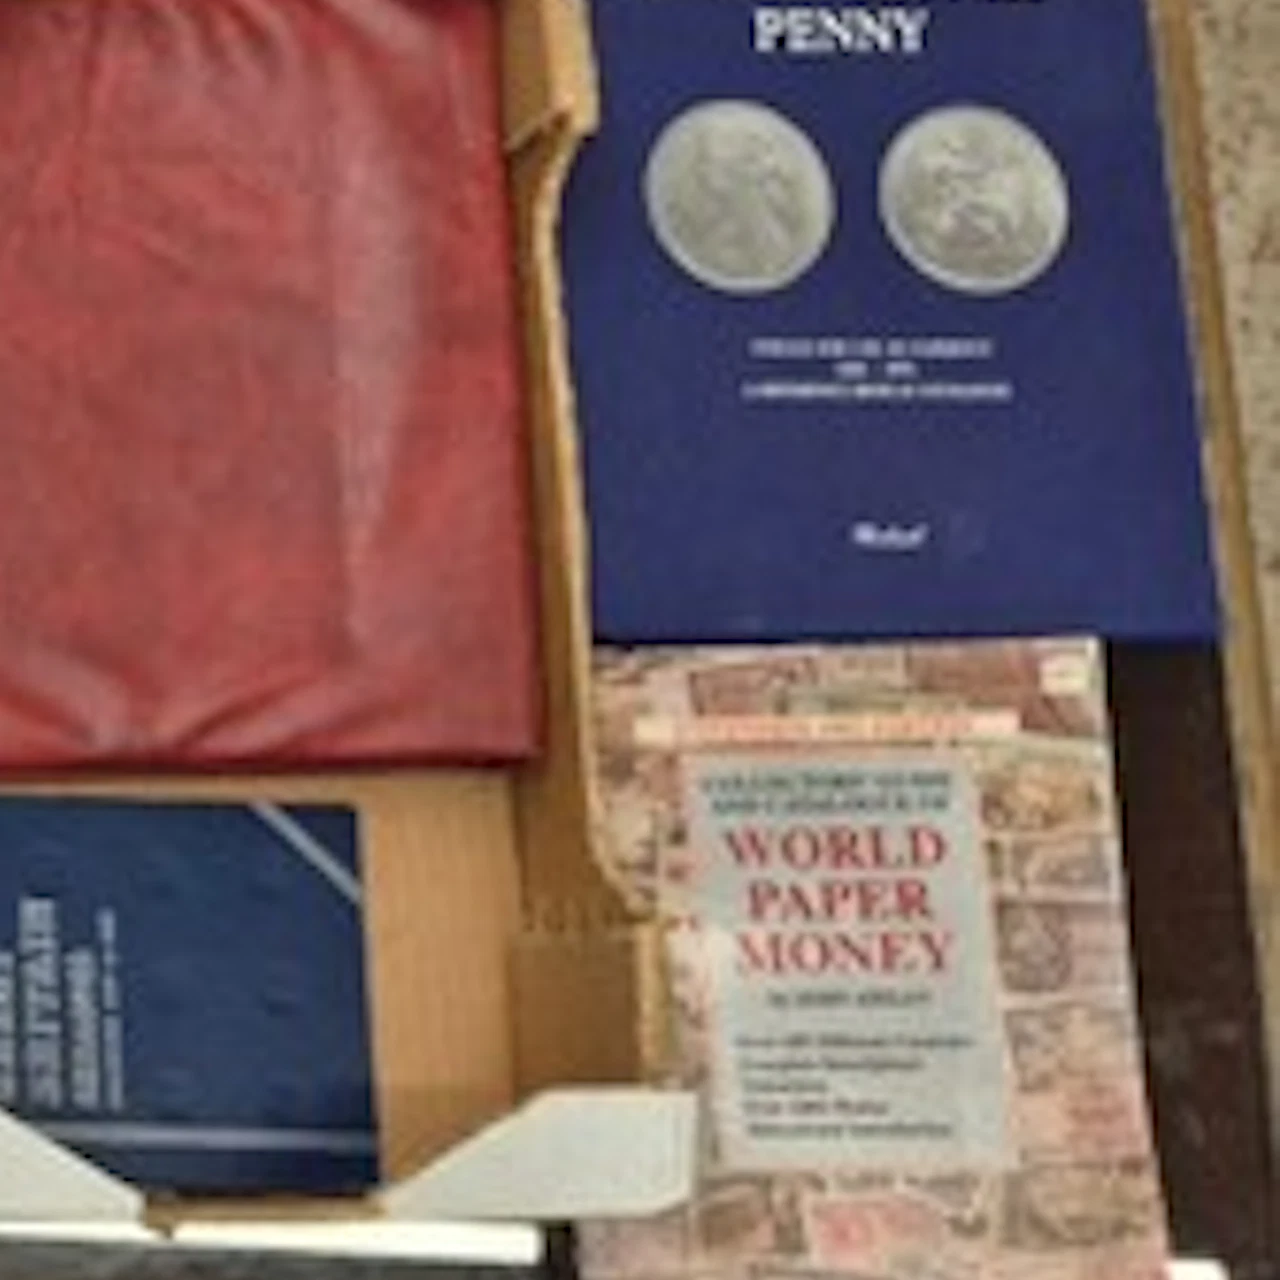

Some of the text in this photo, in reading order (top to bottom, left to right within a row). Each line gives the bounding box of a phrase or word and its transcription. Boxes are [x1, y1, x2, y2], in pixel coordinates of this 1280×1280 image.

[753, 7, 929, 54] PENNY
[724, 826, 947, 870] WORLD
[748, 879, 932, 920] PAPER
[739, 930, 954, 972] MONEY
[18, 897, 63, 1109] BRITAIN
